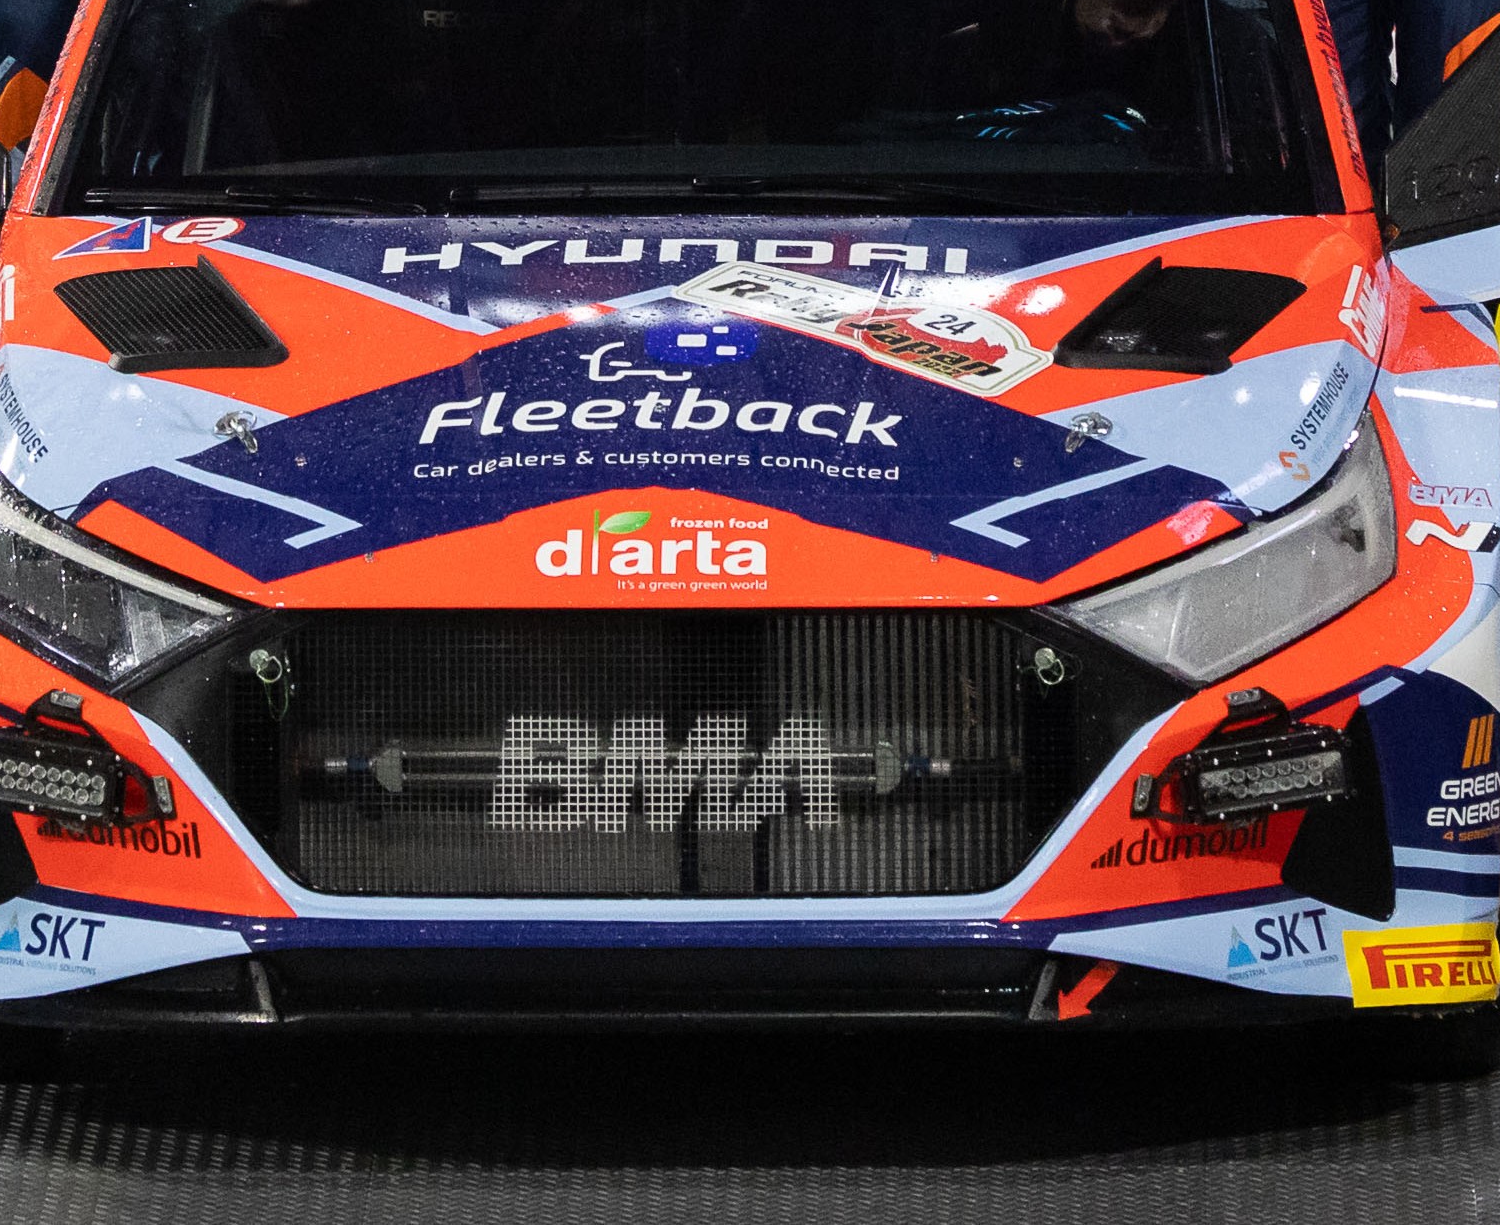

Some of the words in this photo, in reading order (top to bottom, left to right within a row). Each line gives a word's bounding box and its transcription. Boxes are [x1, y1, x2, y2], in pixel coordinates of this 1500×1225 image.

[380, 236, 970, 275] HYUNDAI
[925, 313, 975, 336] 24
[846, 320, 1003, 377] Japan
[418, 386, 903, 448] Fleetback
[1290, 361, 1350, 451] SYSTEMHOUSE
[413, 462, 458, 480] Car
[468, 451, 566, 477] dealers
[575, 450, 594, 465] &
[604, 449, 751, 467] customers
[760, 452, 900, 481] connected
[1409, 482, 1493, 508] BMA
[670, 517, 724, 529] frozen
[729, 518, 769, 529] food
[617, 580, 635, 590] It's
[638, 582, 645, 590] a
[649, 581, 686, 593] green
[690, 581, 727, 592] green
[730, 580, 768, 590] world
[486, 712, 842, 833] BMA
[25, 912, 105, 961] SKT
[1254, 907, 1327, 961] SKT
[59, 964, 97, 976] SOLUTIONS
[1227, 969, 1267, 981] INDUSTRIAL
[1303, 955, 1339, 967] SOLUTIONS
[1361, 938, 1497, 990] PIRELLI
